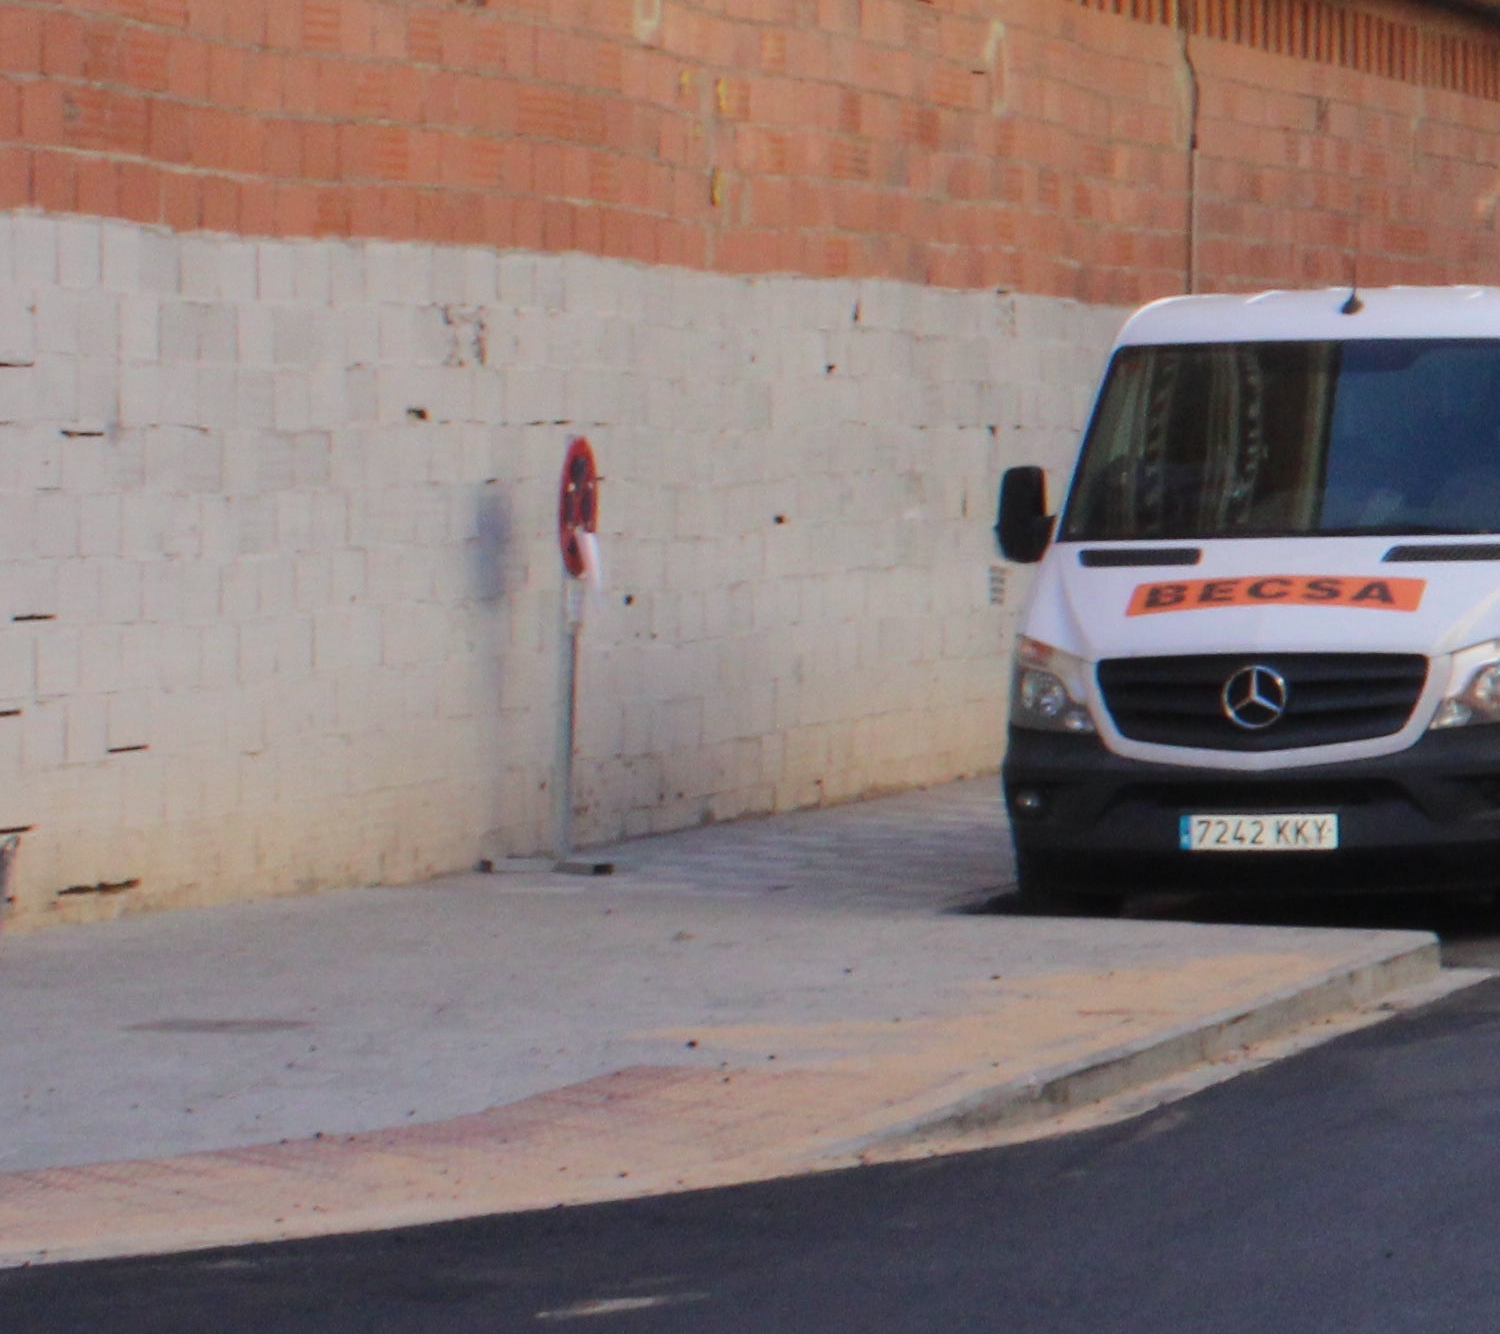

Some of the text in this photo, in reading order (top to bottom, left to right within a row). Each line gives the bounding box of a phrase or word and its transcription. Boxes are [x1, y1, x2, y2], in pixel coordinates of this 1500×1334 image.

[1144, 577, 1395, 608] BECSA
[1197, 818, 1328, 844] 7242 KKY
